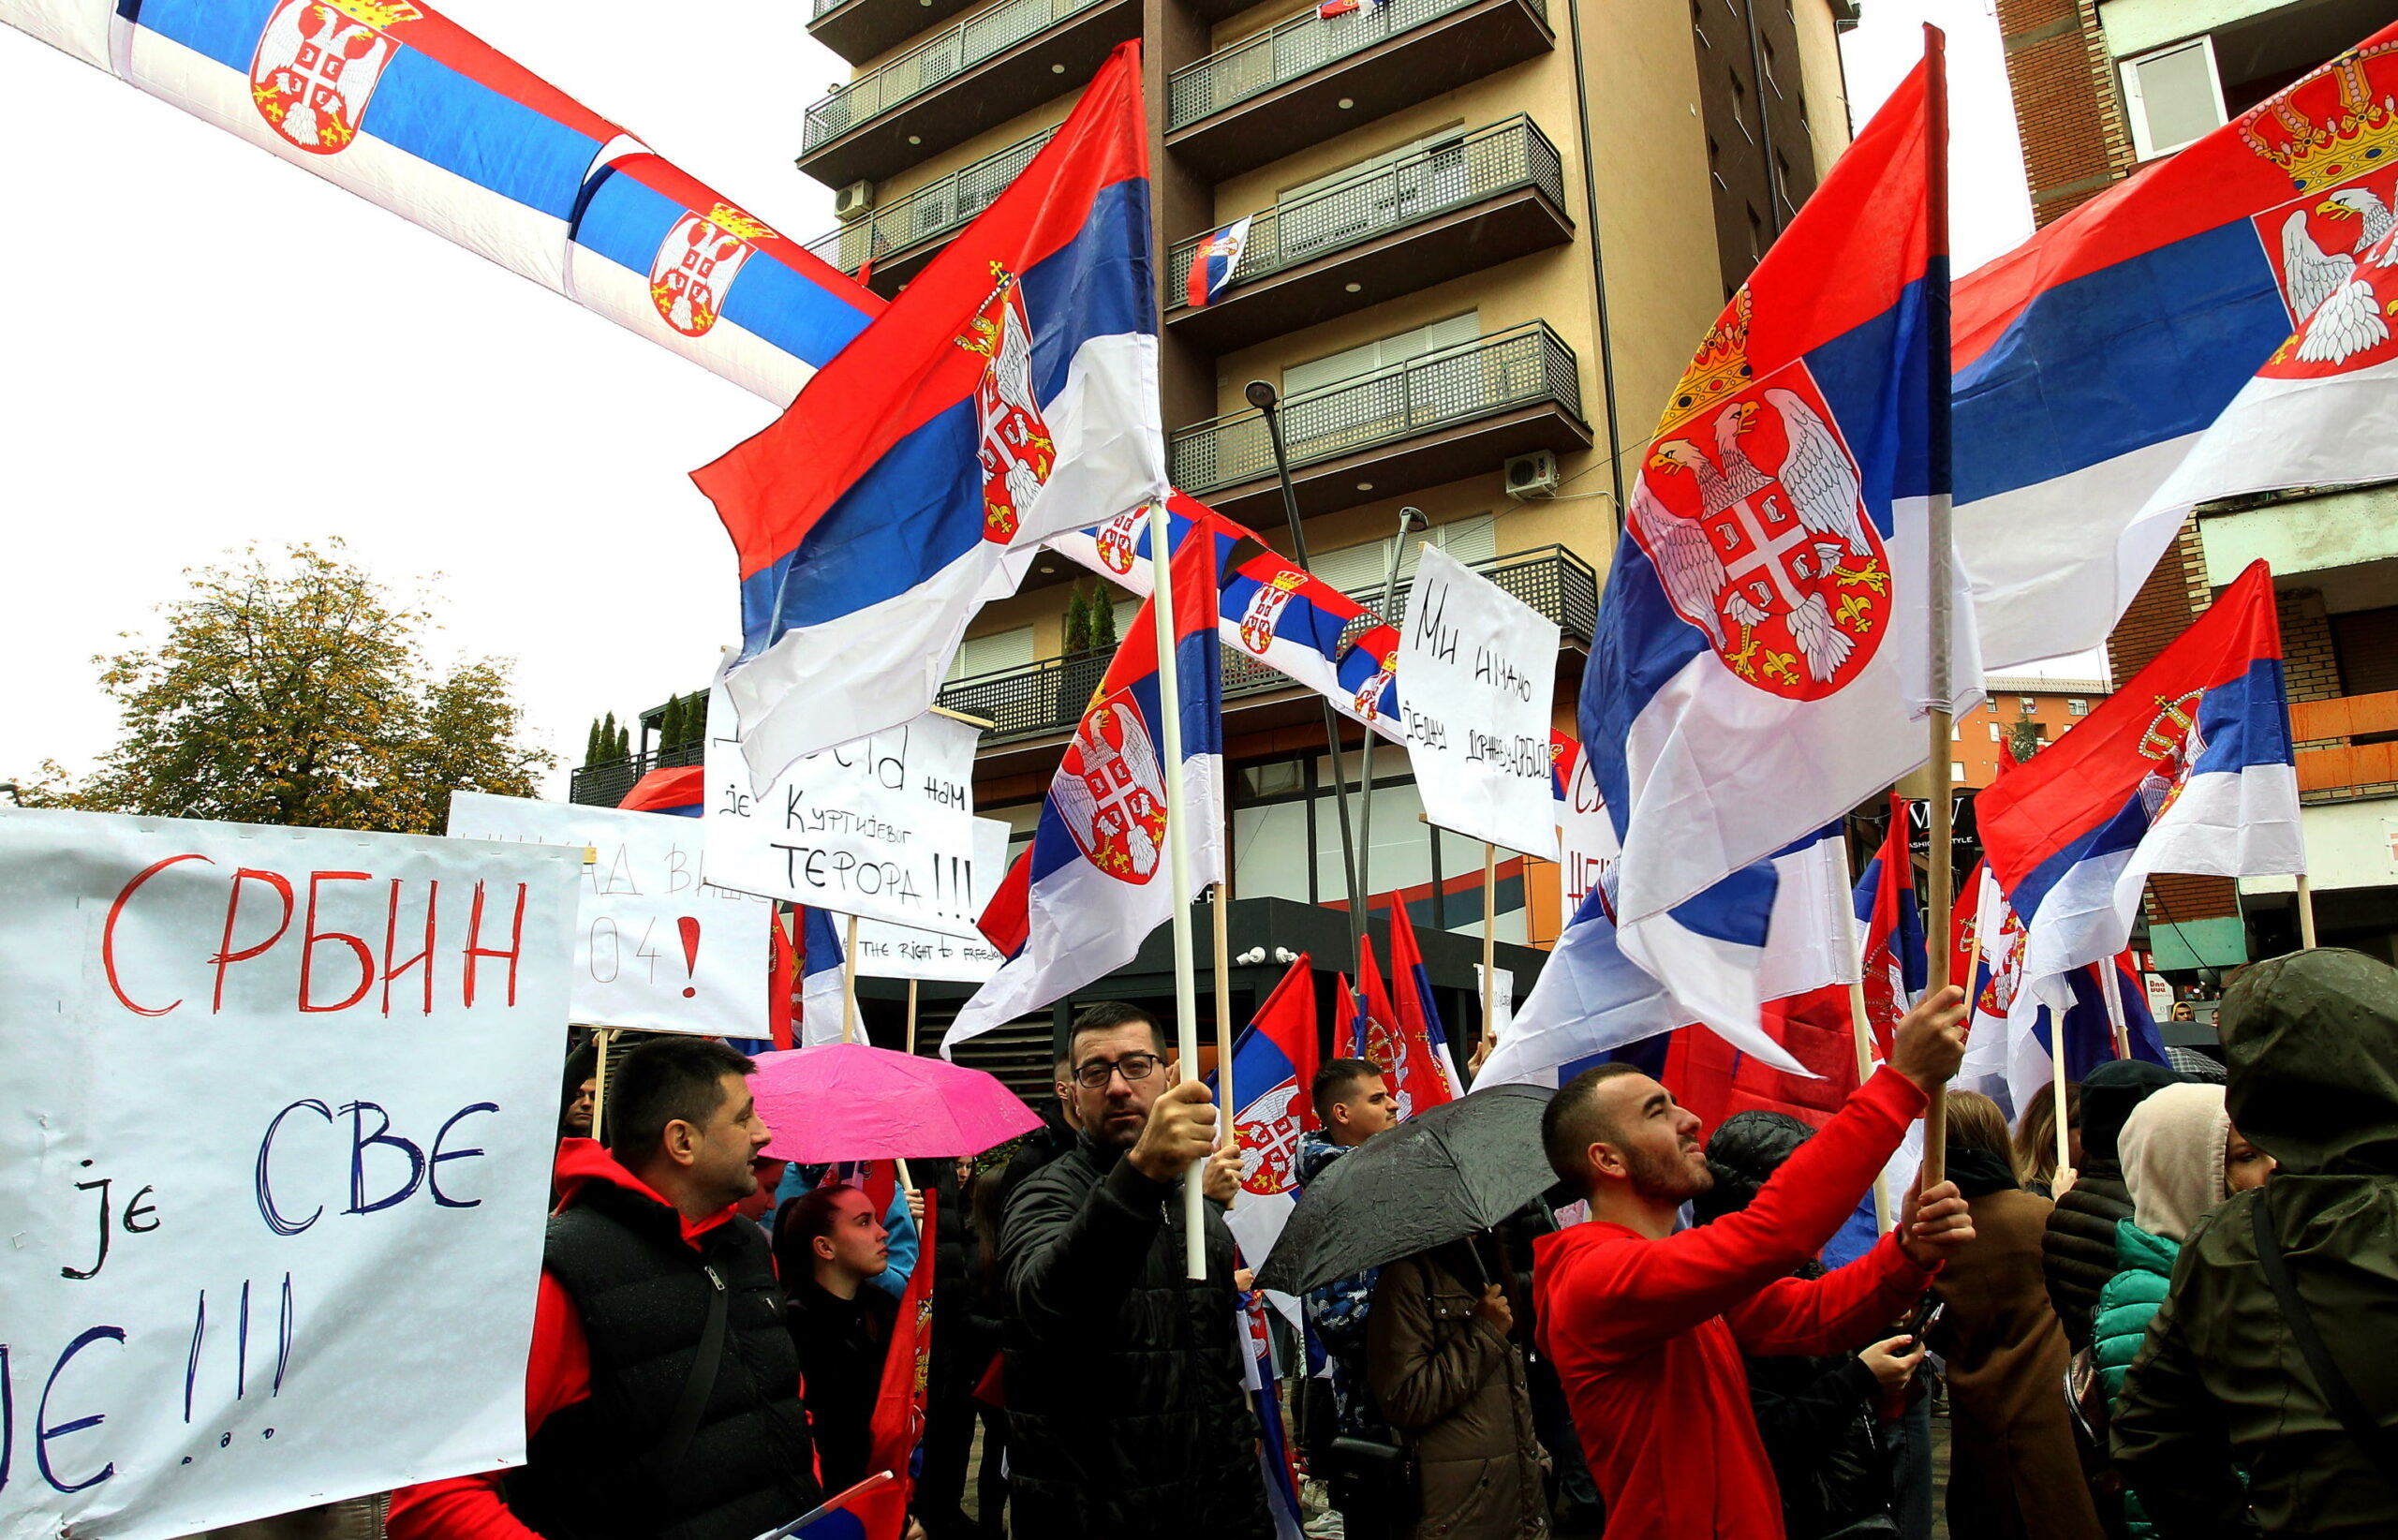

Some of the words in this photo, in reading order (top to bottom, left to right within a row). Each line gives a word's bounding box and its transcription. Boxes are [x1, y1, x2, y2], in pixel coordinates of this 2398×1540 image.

[100, 853, 527, 1018] СРБИН
[859, 940, 889, 956] THE
[255, 1097, 501, 1237] СВЕ
